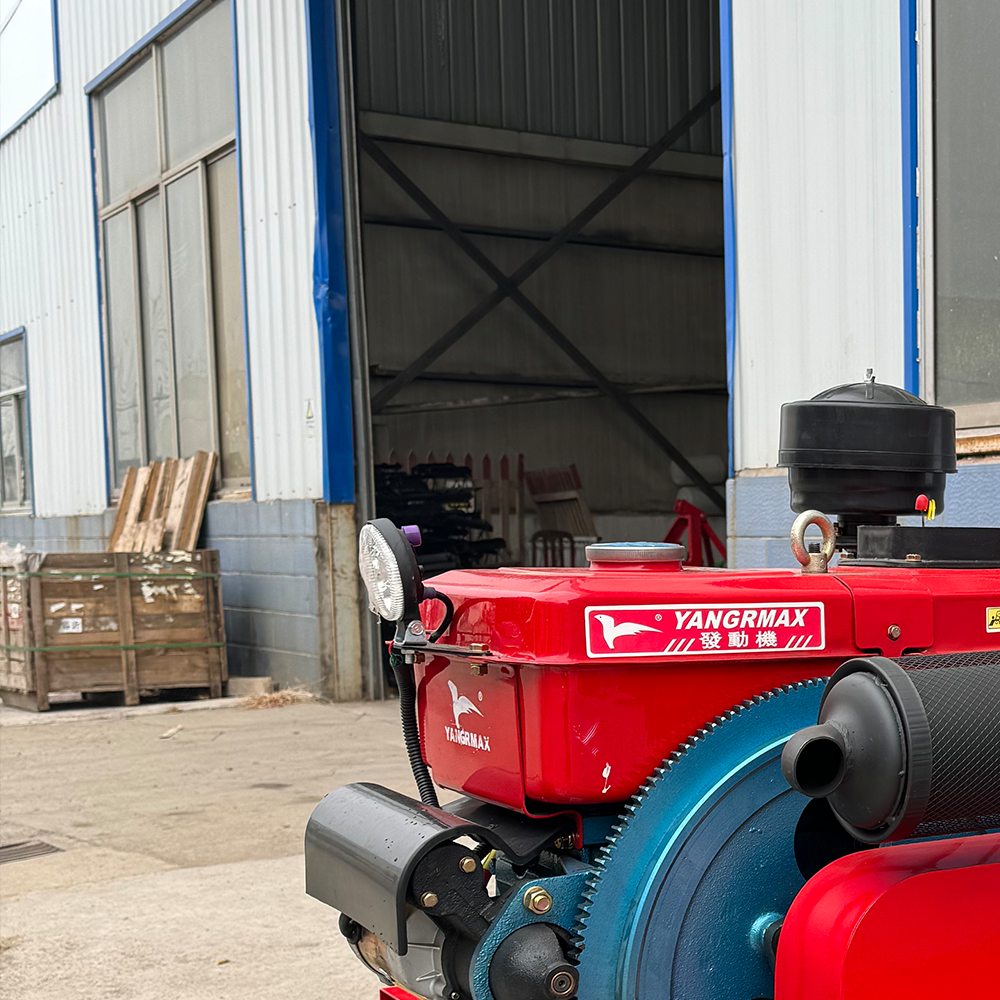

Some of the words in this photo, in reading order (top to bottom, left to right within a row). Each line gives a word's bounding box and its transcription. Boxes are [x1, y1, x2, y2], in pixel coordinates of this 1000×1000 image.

[674, 608, 809, 630] YANGRMAX
[699, 630, 778, 650] 發動機
[444, 725, 491, 752] YANGRMAX
